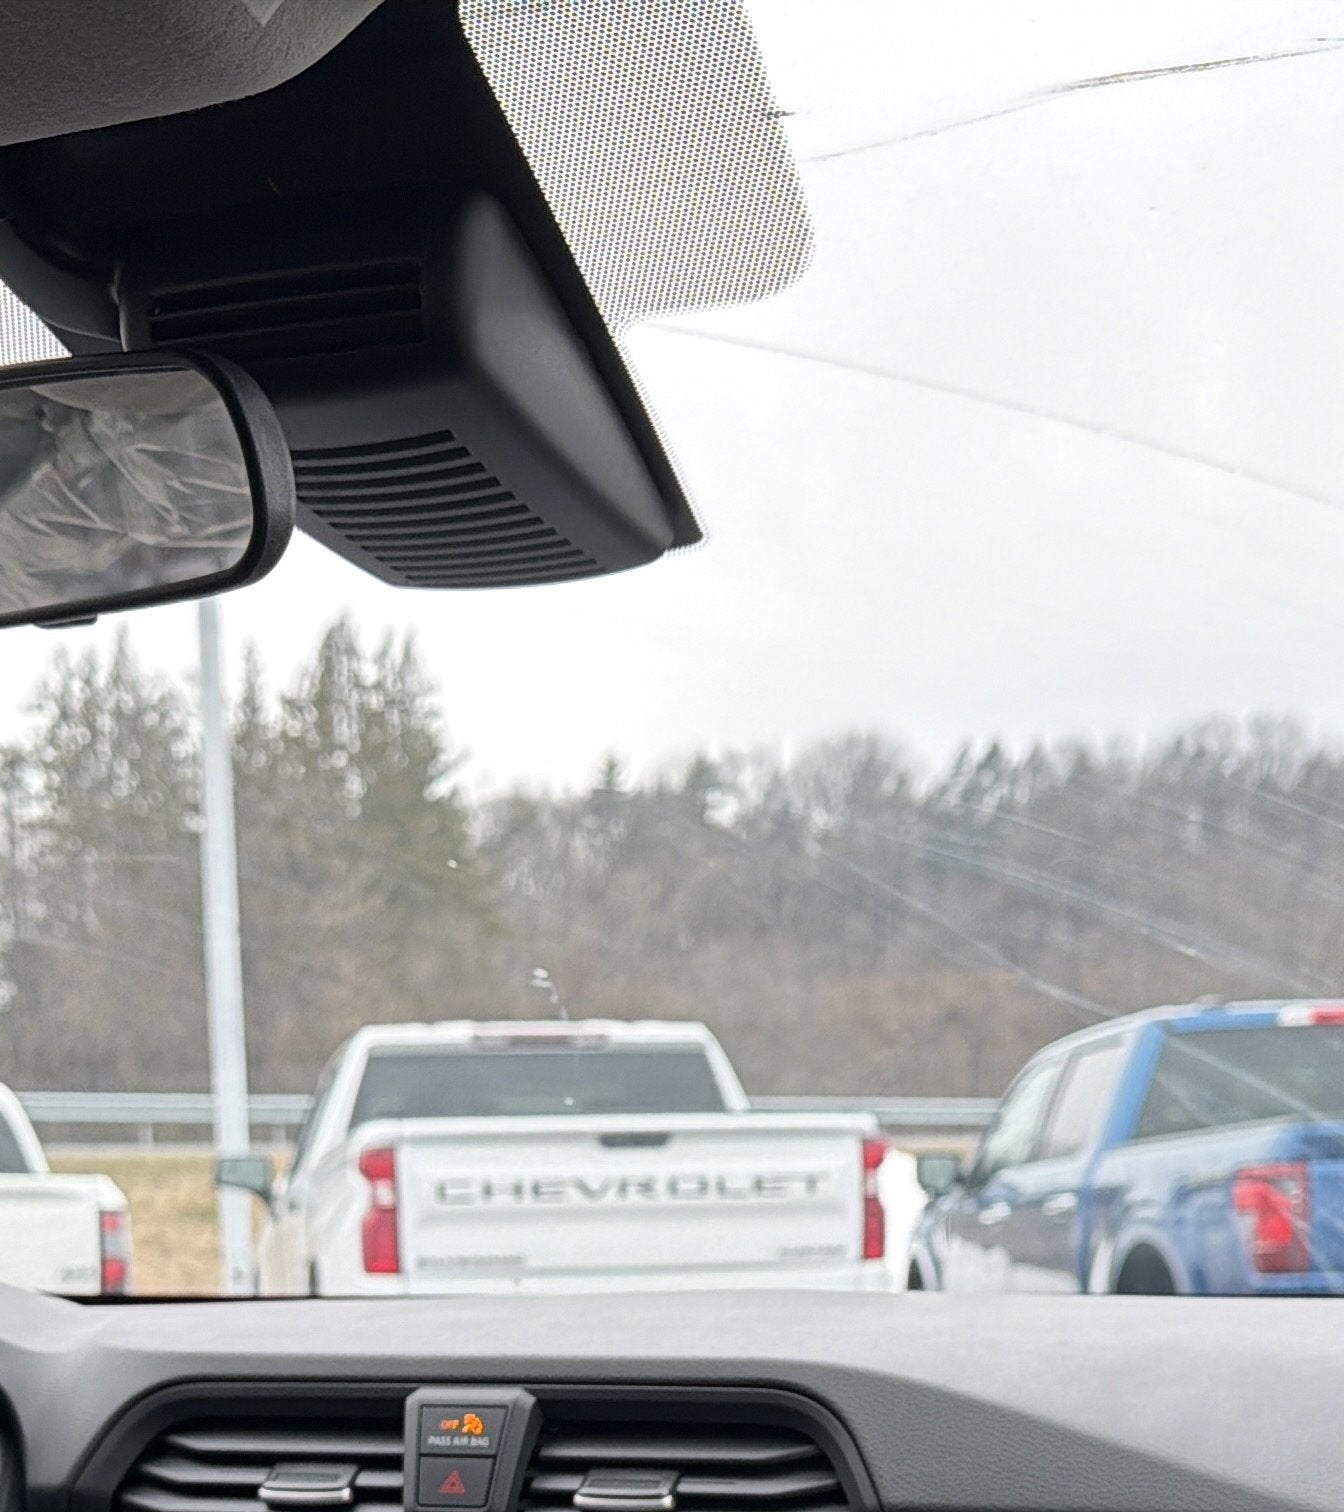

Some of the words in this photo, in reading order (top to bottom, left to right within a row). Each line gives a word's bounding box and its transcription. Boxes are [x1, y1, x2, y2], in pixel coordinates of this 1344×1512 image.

[435, 1171, 829, 1205] CHEVROLET
[428, 1436, 451, 1446] PASS
[453, 1436, 469, 1446] AIR
[470, 1436, 490, 1447] BAG
